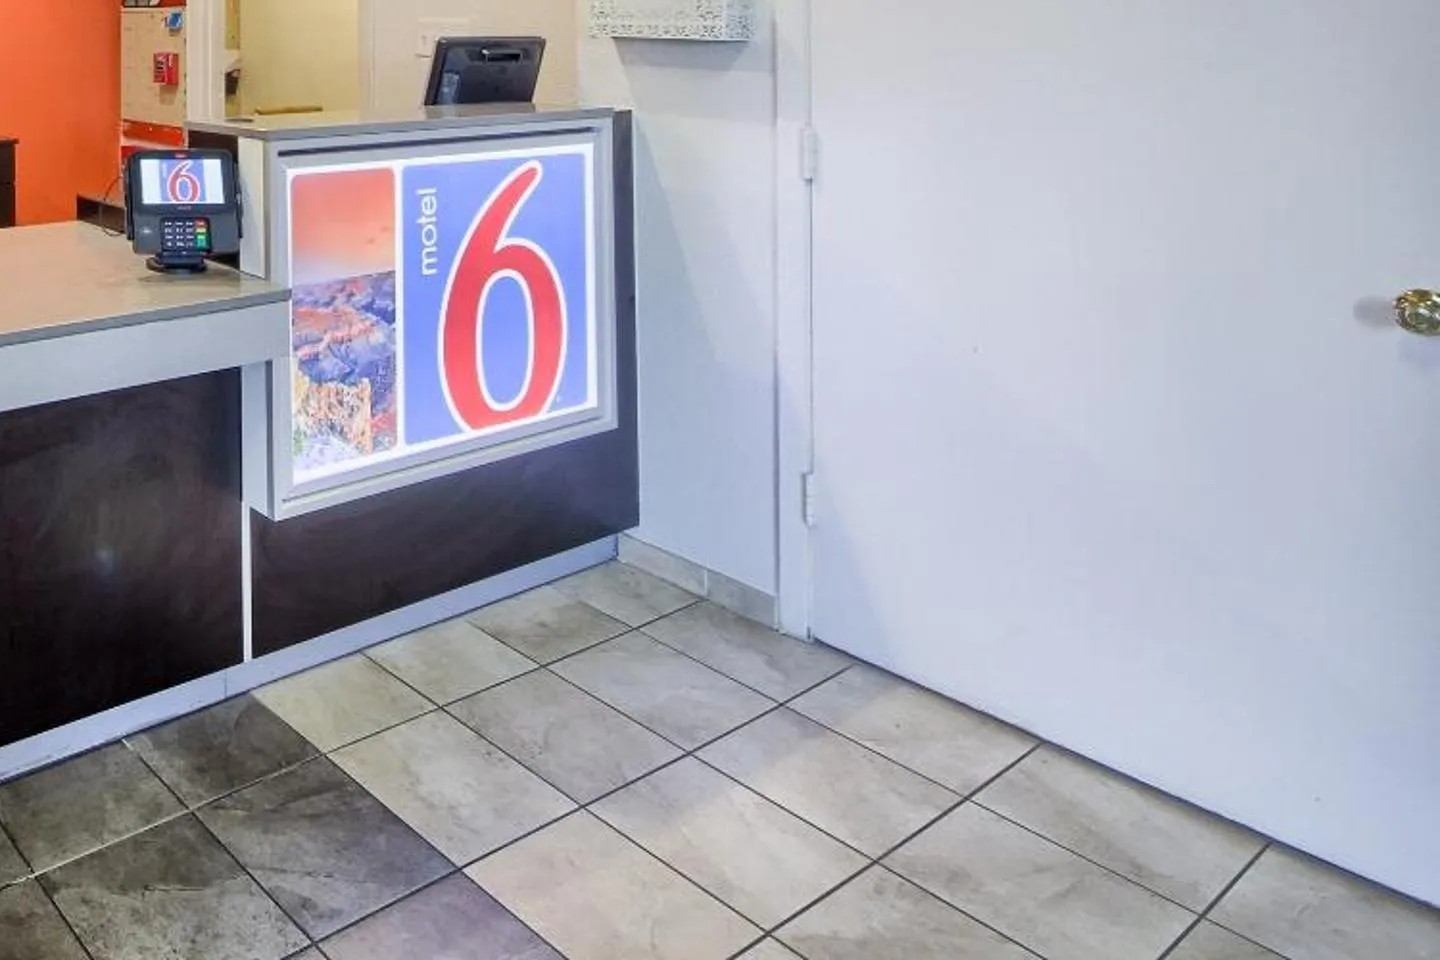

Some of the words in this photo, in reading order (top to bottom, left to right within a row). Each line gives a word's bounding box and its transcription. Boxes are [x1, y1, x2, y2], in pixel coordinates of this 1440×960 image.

[167, 159, 201, 203] 6
[415, 187, 438, 277] motel
[437, 159, 568, 433] 6
